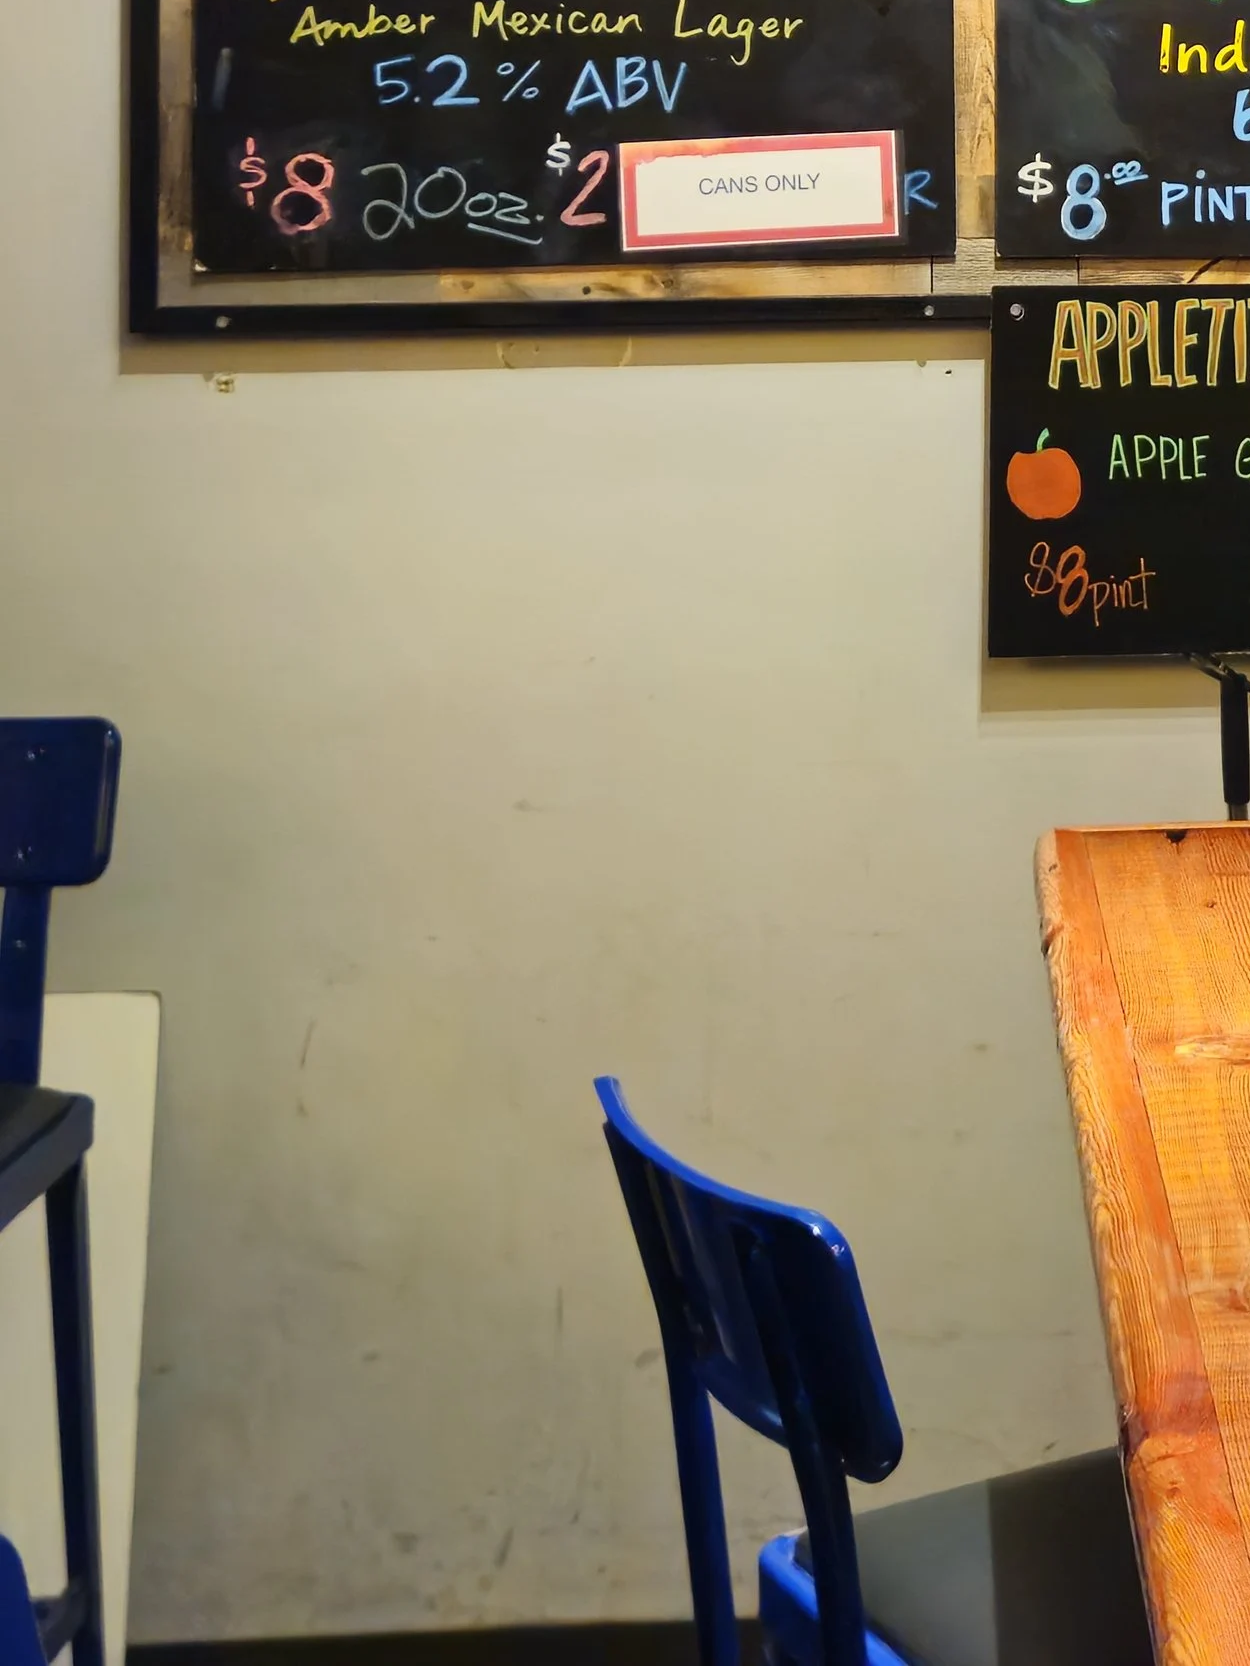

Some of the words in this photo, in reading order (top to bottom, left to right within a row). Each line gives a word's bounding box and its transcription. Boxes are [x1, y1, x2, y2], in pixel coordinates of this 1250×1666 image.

[290, 5, 436, 46] Amber
[472, 1, 642, 40] Mexican
[565, 56, 688, 116] ABV
[238, 136, 336, 235] $8
[698, 175, 758, 198] CANS
[763, 172, 822, 195] ONLY
[1108, 433, 1210, 481] APPLE
[1090, 556, 1158, 627] pint
